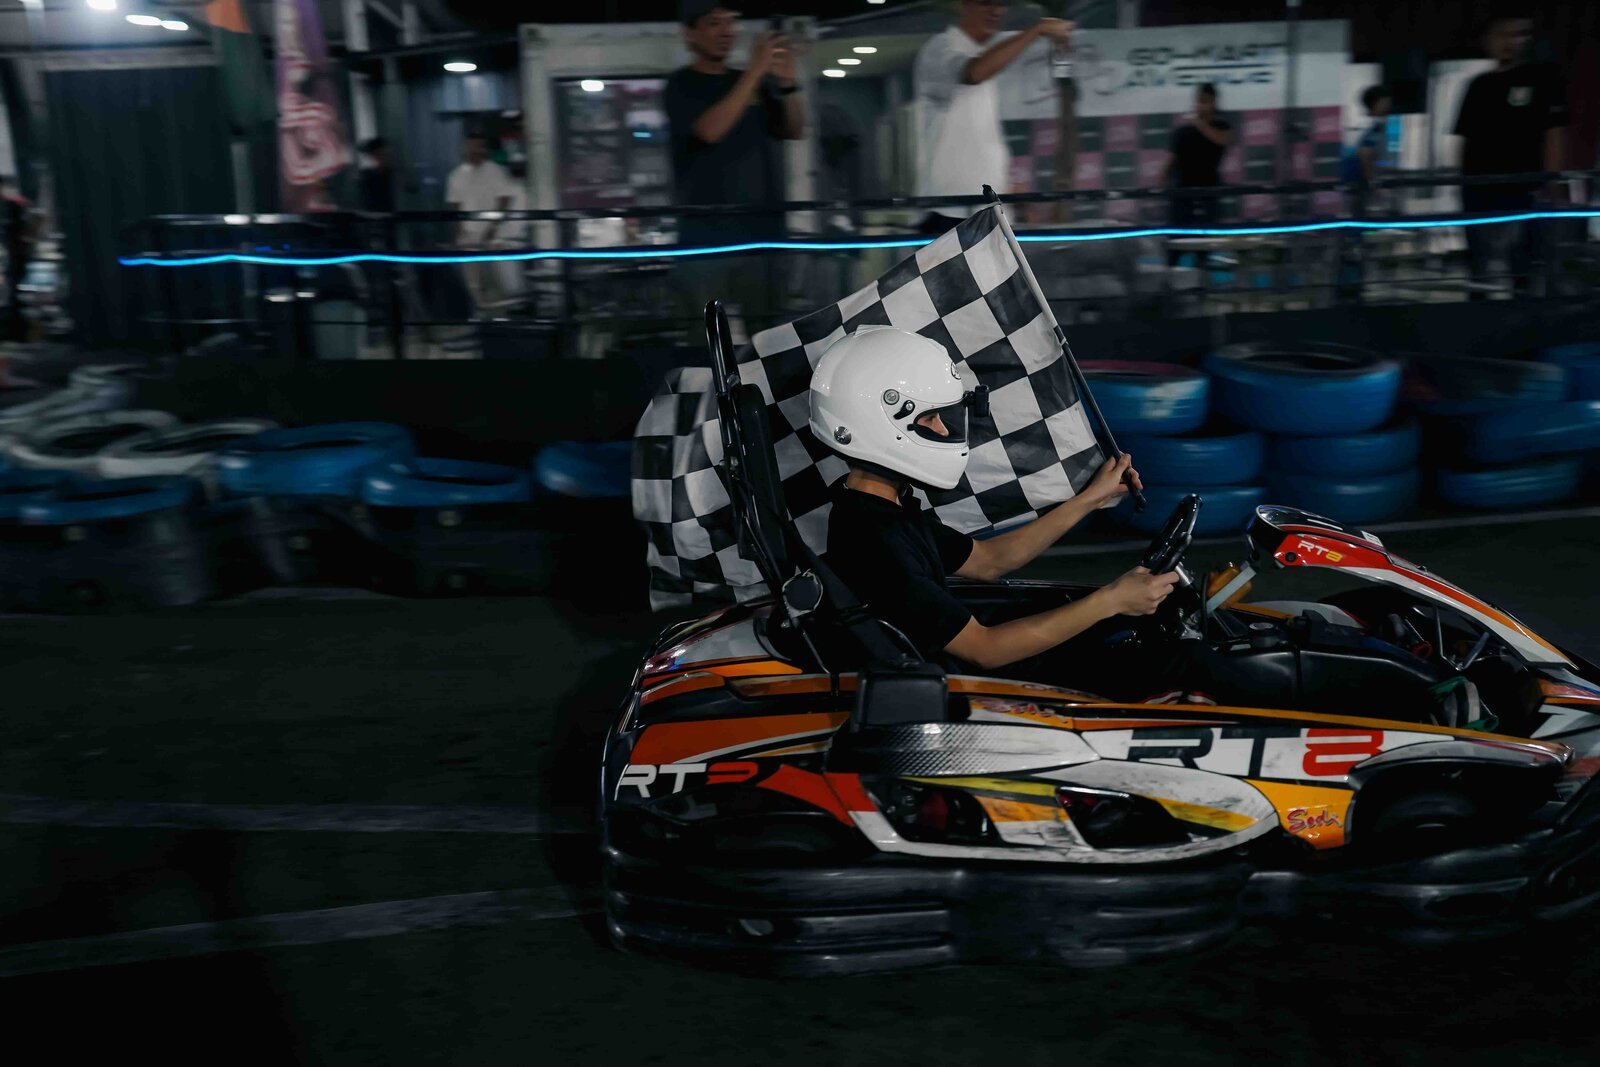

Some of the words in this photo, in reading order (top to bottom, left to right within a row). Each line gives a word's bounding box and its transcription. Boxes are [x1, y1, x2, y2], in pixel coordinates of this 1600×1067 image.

[1297, 540, 1343, 563] RT8
[1127, 728, 1384, 777] RT8
[1286, 808, 1343, 835] Sodi
